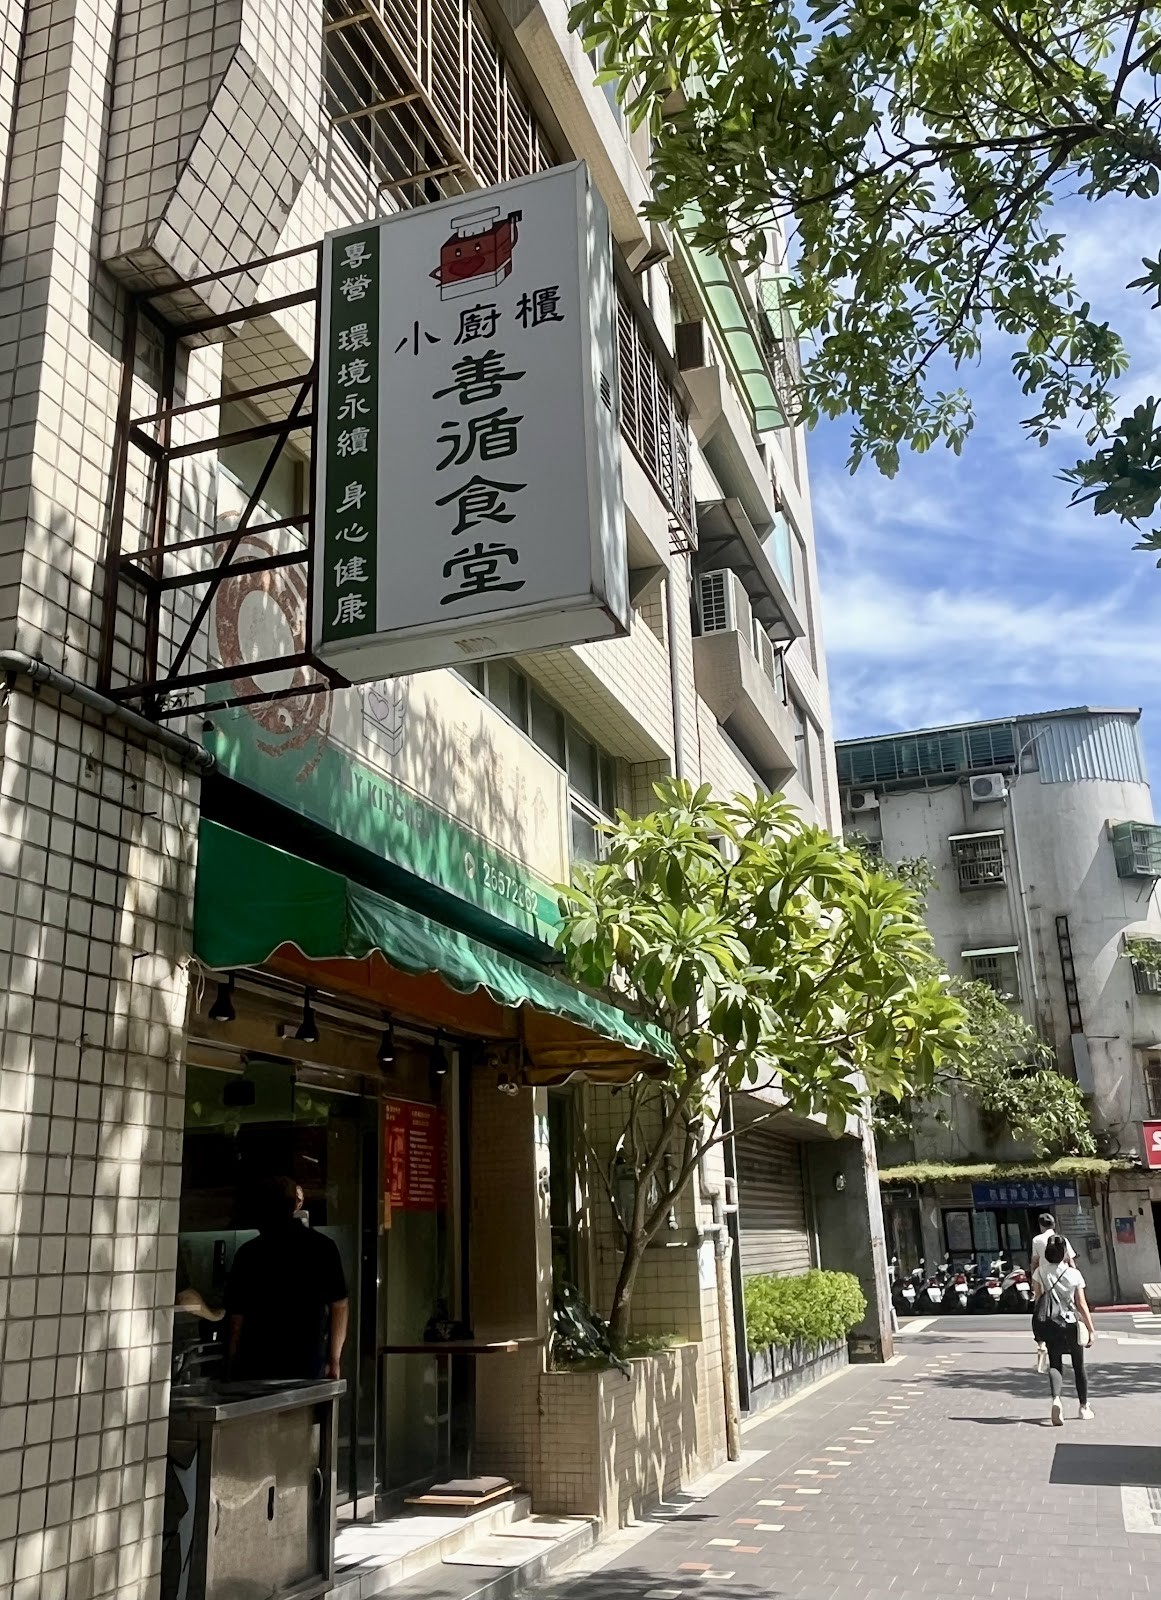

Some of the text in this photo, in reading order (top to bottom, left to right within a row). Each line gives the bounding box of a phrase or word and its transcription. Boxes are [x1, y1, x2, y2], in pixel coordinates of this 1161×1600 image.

[336, 322, 372, 458] 環境永續
[394, 285, 565, 356] 小廚櫃
[431, 349, 527, 604] 善循食堂
[331, 480, 370, 626] 身心健康
